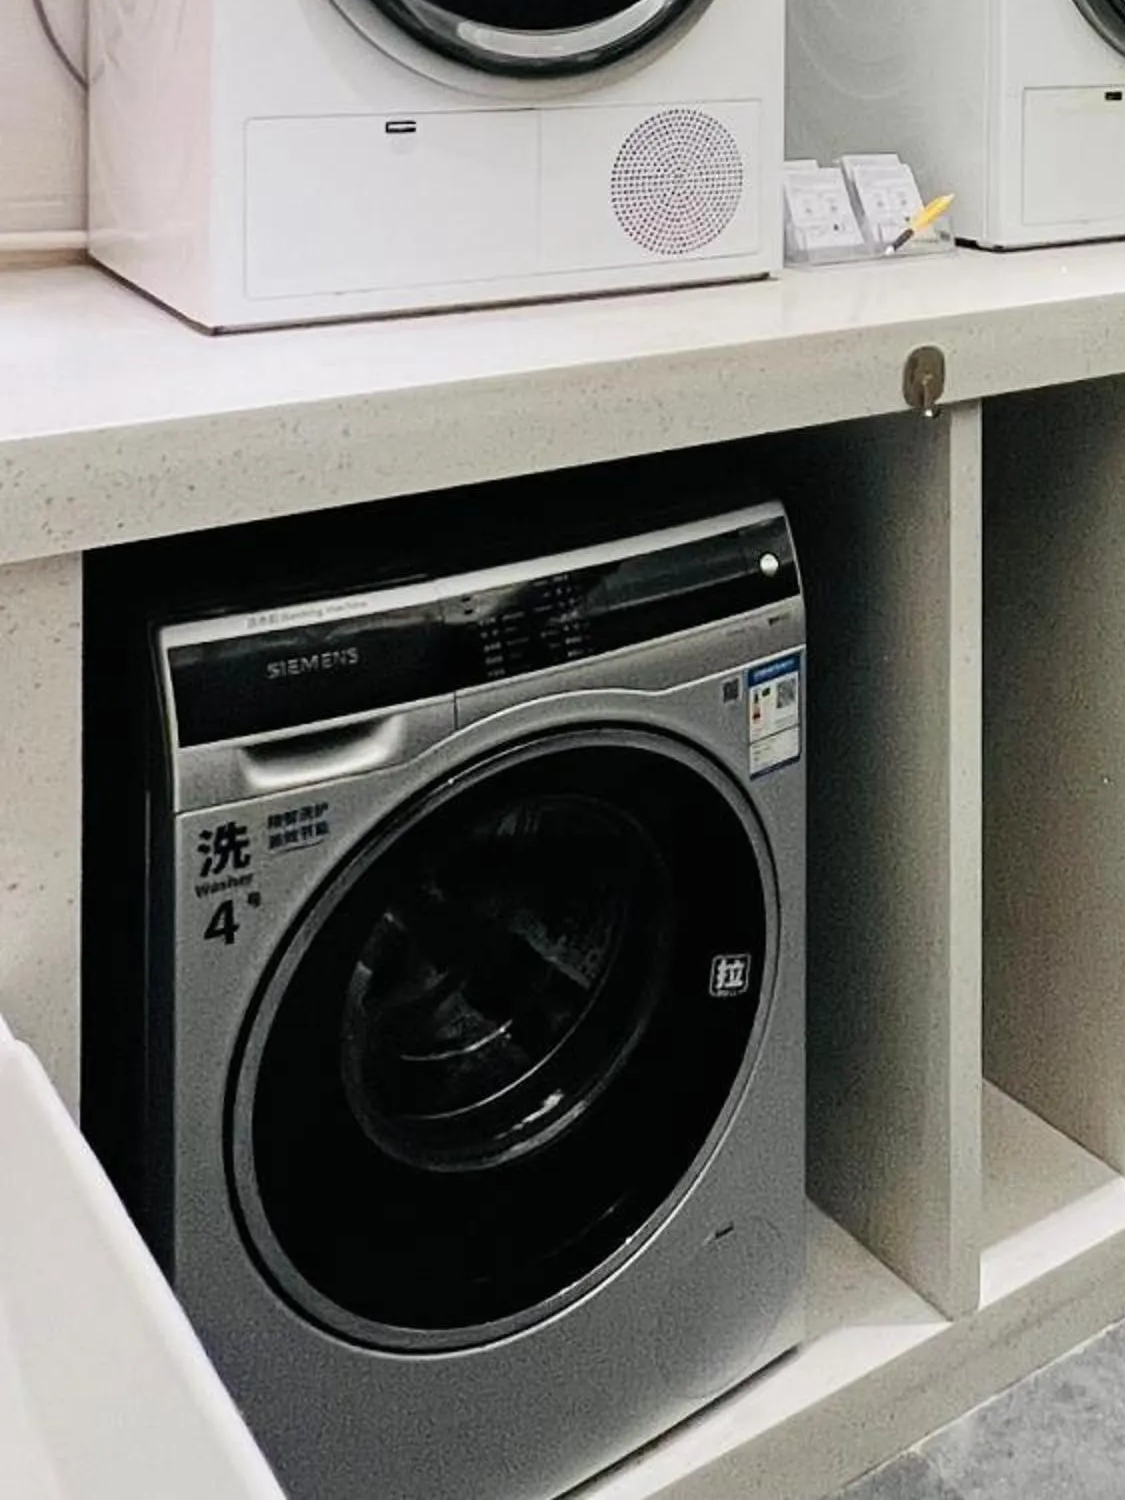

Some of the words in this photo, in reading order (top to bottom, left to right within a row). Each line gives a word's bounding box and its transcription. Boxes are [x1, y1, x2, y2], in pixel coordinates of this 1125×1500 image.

[266, 647, 360, 680] SIEMENS
[197, 820, 251, 877] 洗
[195, 873, 254, 898] Washer
[715, 958, 745, 989] 拉
